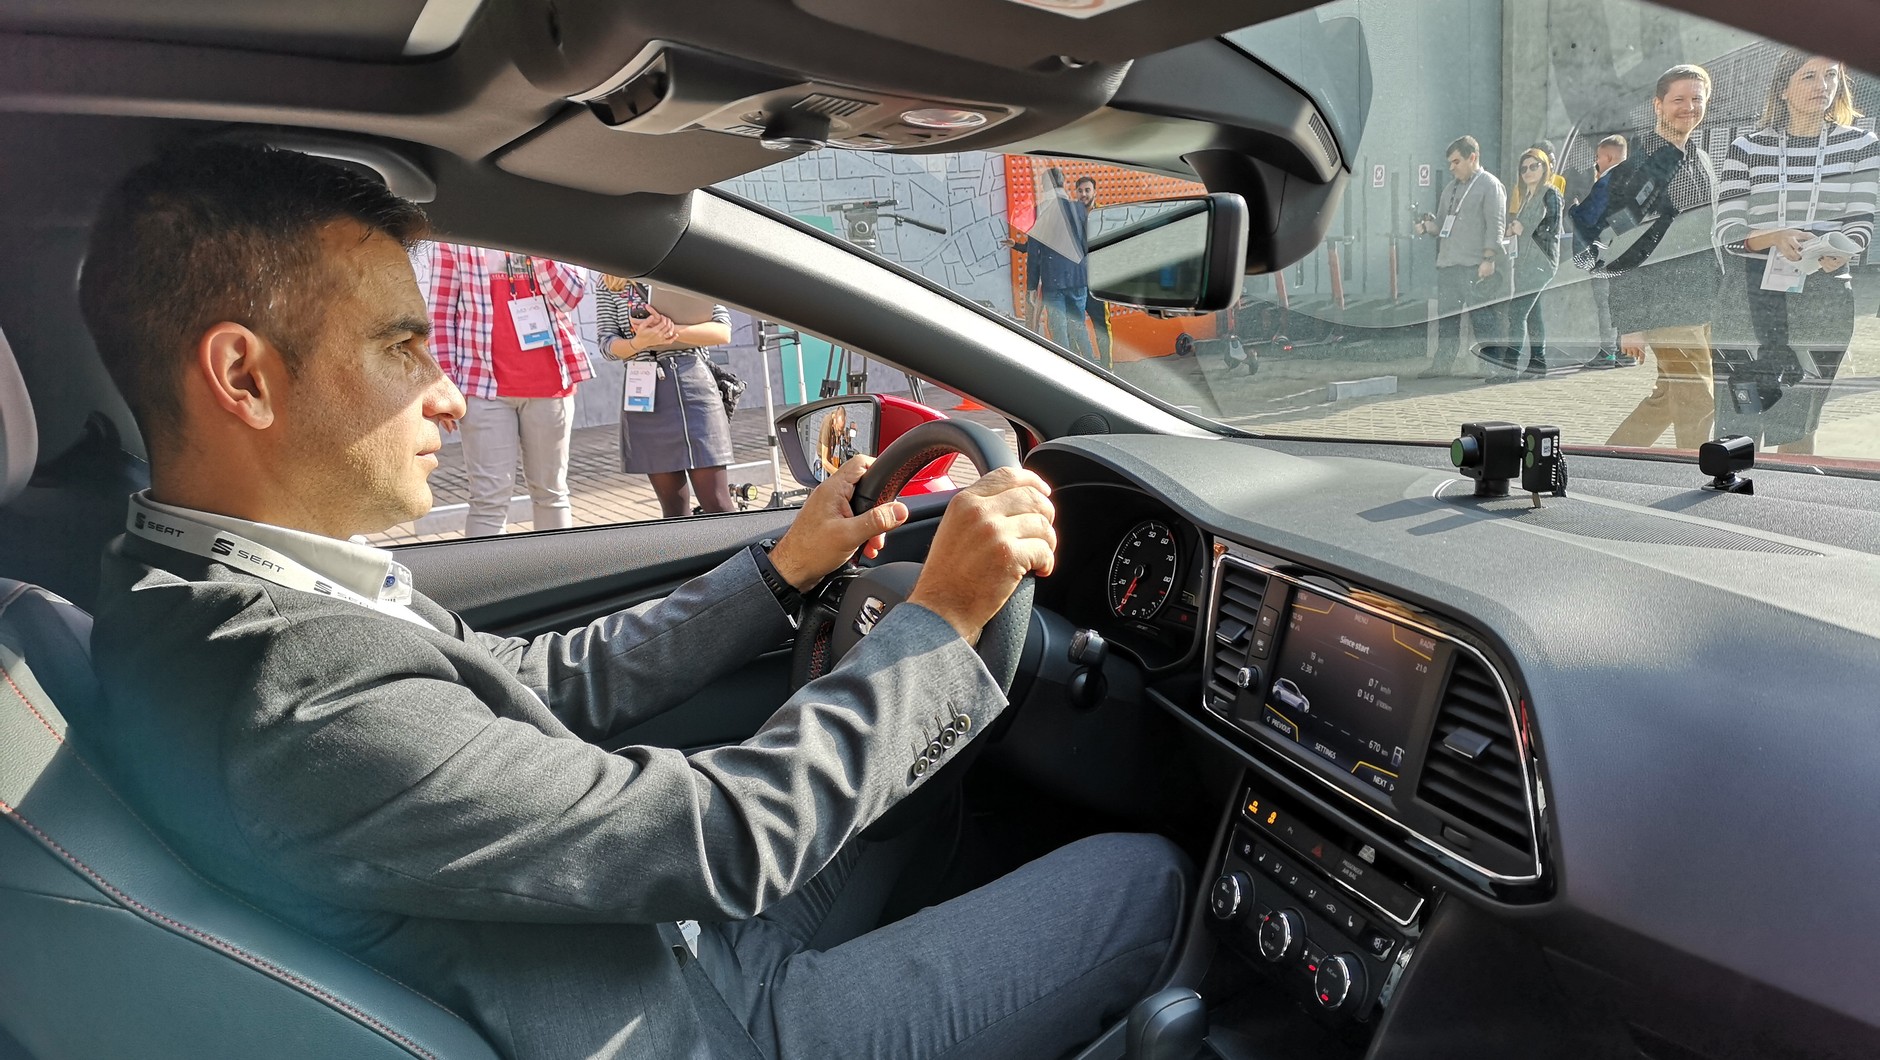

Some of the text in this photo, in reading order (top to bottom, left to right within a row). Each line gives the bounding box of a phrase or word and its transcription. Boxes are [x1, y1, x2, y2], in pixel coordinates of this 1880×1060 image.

[147, 521, 185, 538] SEAT
[237, 549, 285, 573] SEAT
[1339, 635, 1370, 655] Since start
[1271, 718, 1292, 735] PREVIOUS
[1314, 742, 1337, 760] SETTINGS
[1368, 739, 1381, 753] 670
[1372, 774, 1388, 788] NEXT
